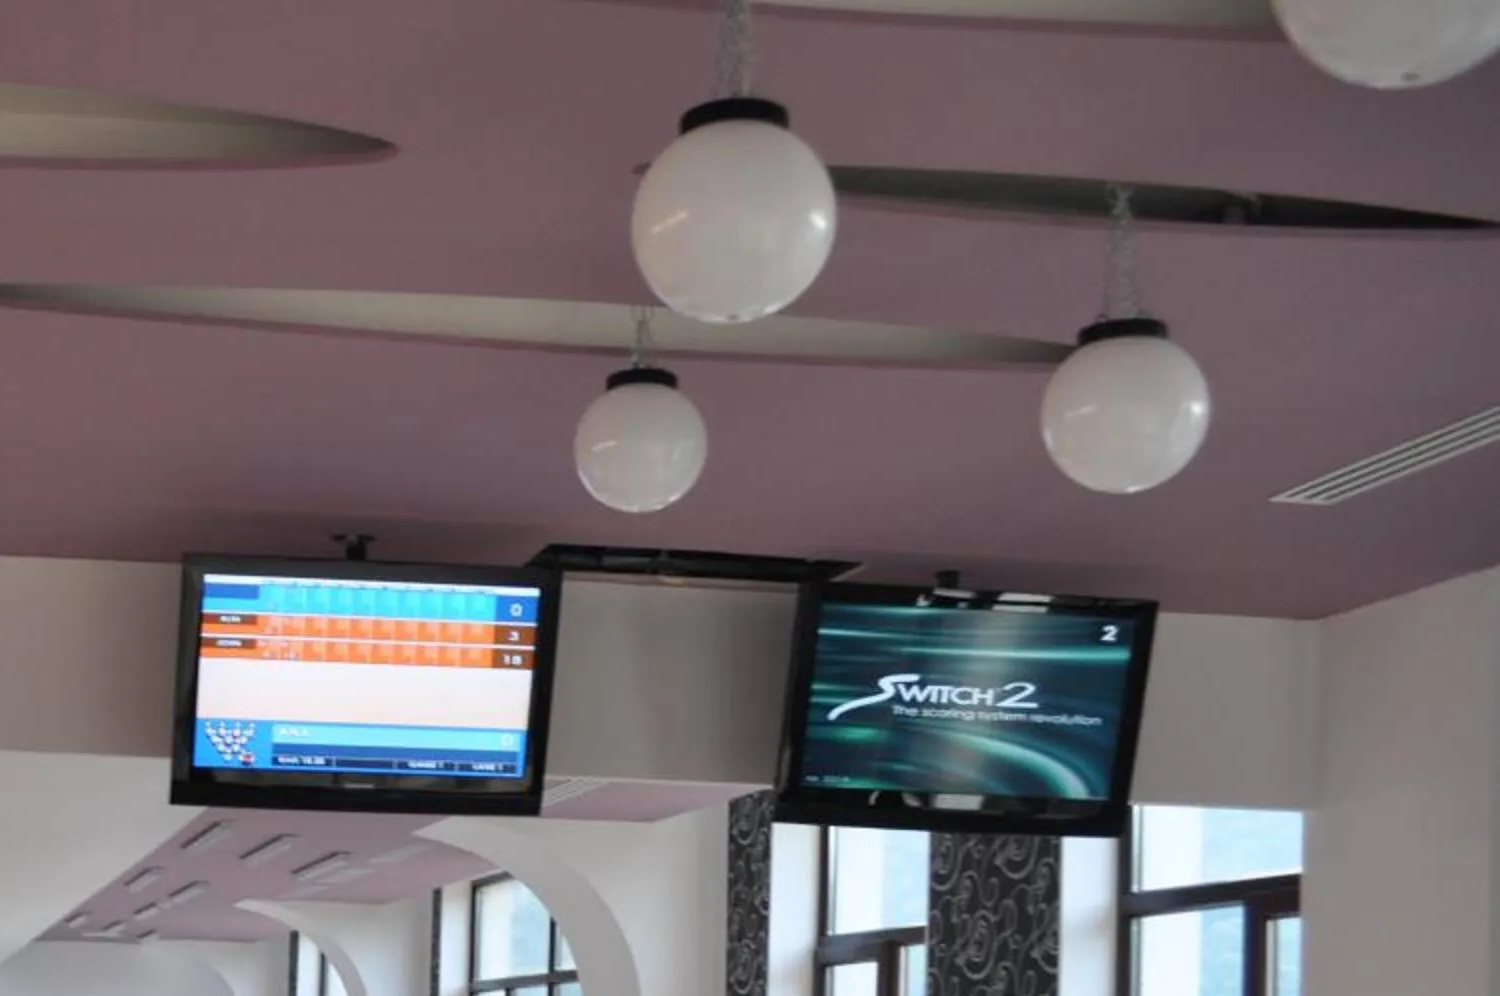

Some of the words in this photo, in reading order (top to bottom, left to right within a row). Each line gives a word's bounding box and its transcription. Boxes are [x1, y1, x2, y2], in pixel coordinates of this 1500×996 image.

[1100, 625, 1119, 641] 2
[892, 705, 918, 716] The
[921, 707, 975, 721] scoring
[977, 710, 1027, 722] system
[1030, 712, 1103, 725] revolution
